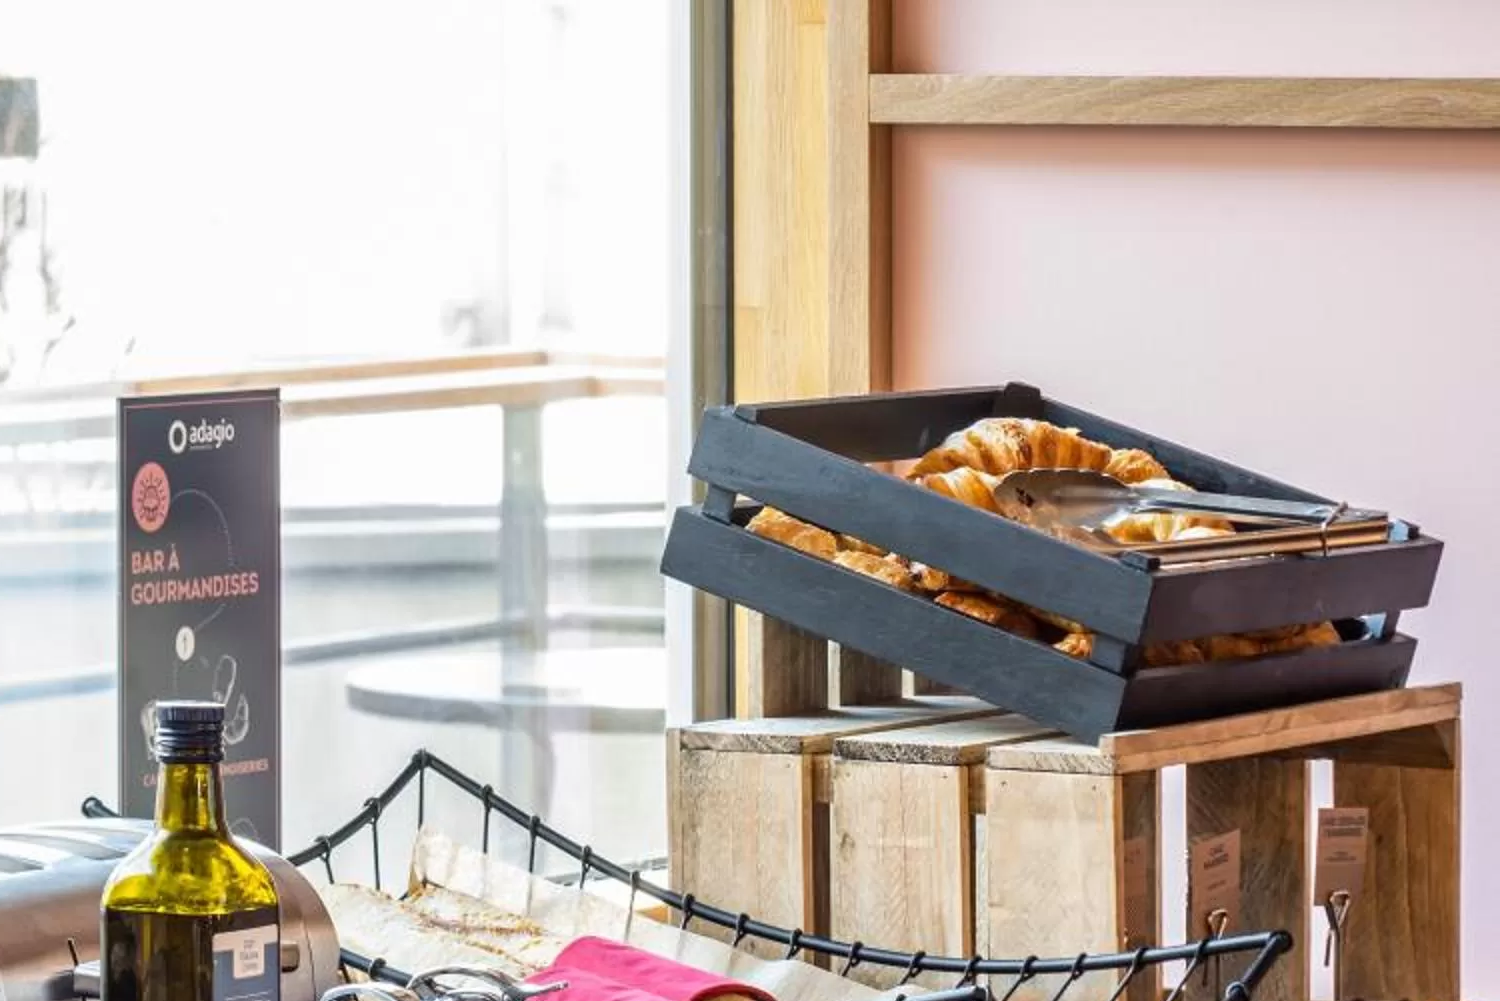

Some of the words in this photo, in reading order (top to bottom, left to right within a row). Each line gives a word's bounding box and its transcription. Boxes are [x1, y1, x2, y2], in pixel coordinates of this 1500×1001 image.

[189, 418, 235, 448] adagio
[131, 549, 164, 574] BAR
[131, 572, 260, 605] GOURMANDISES
